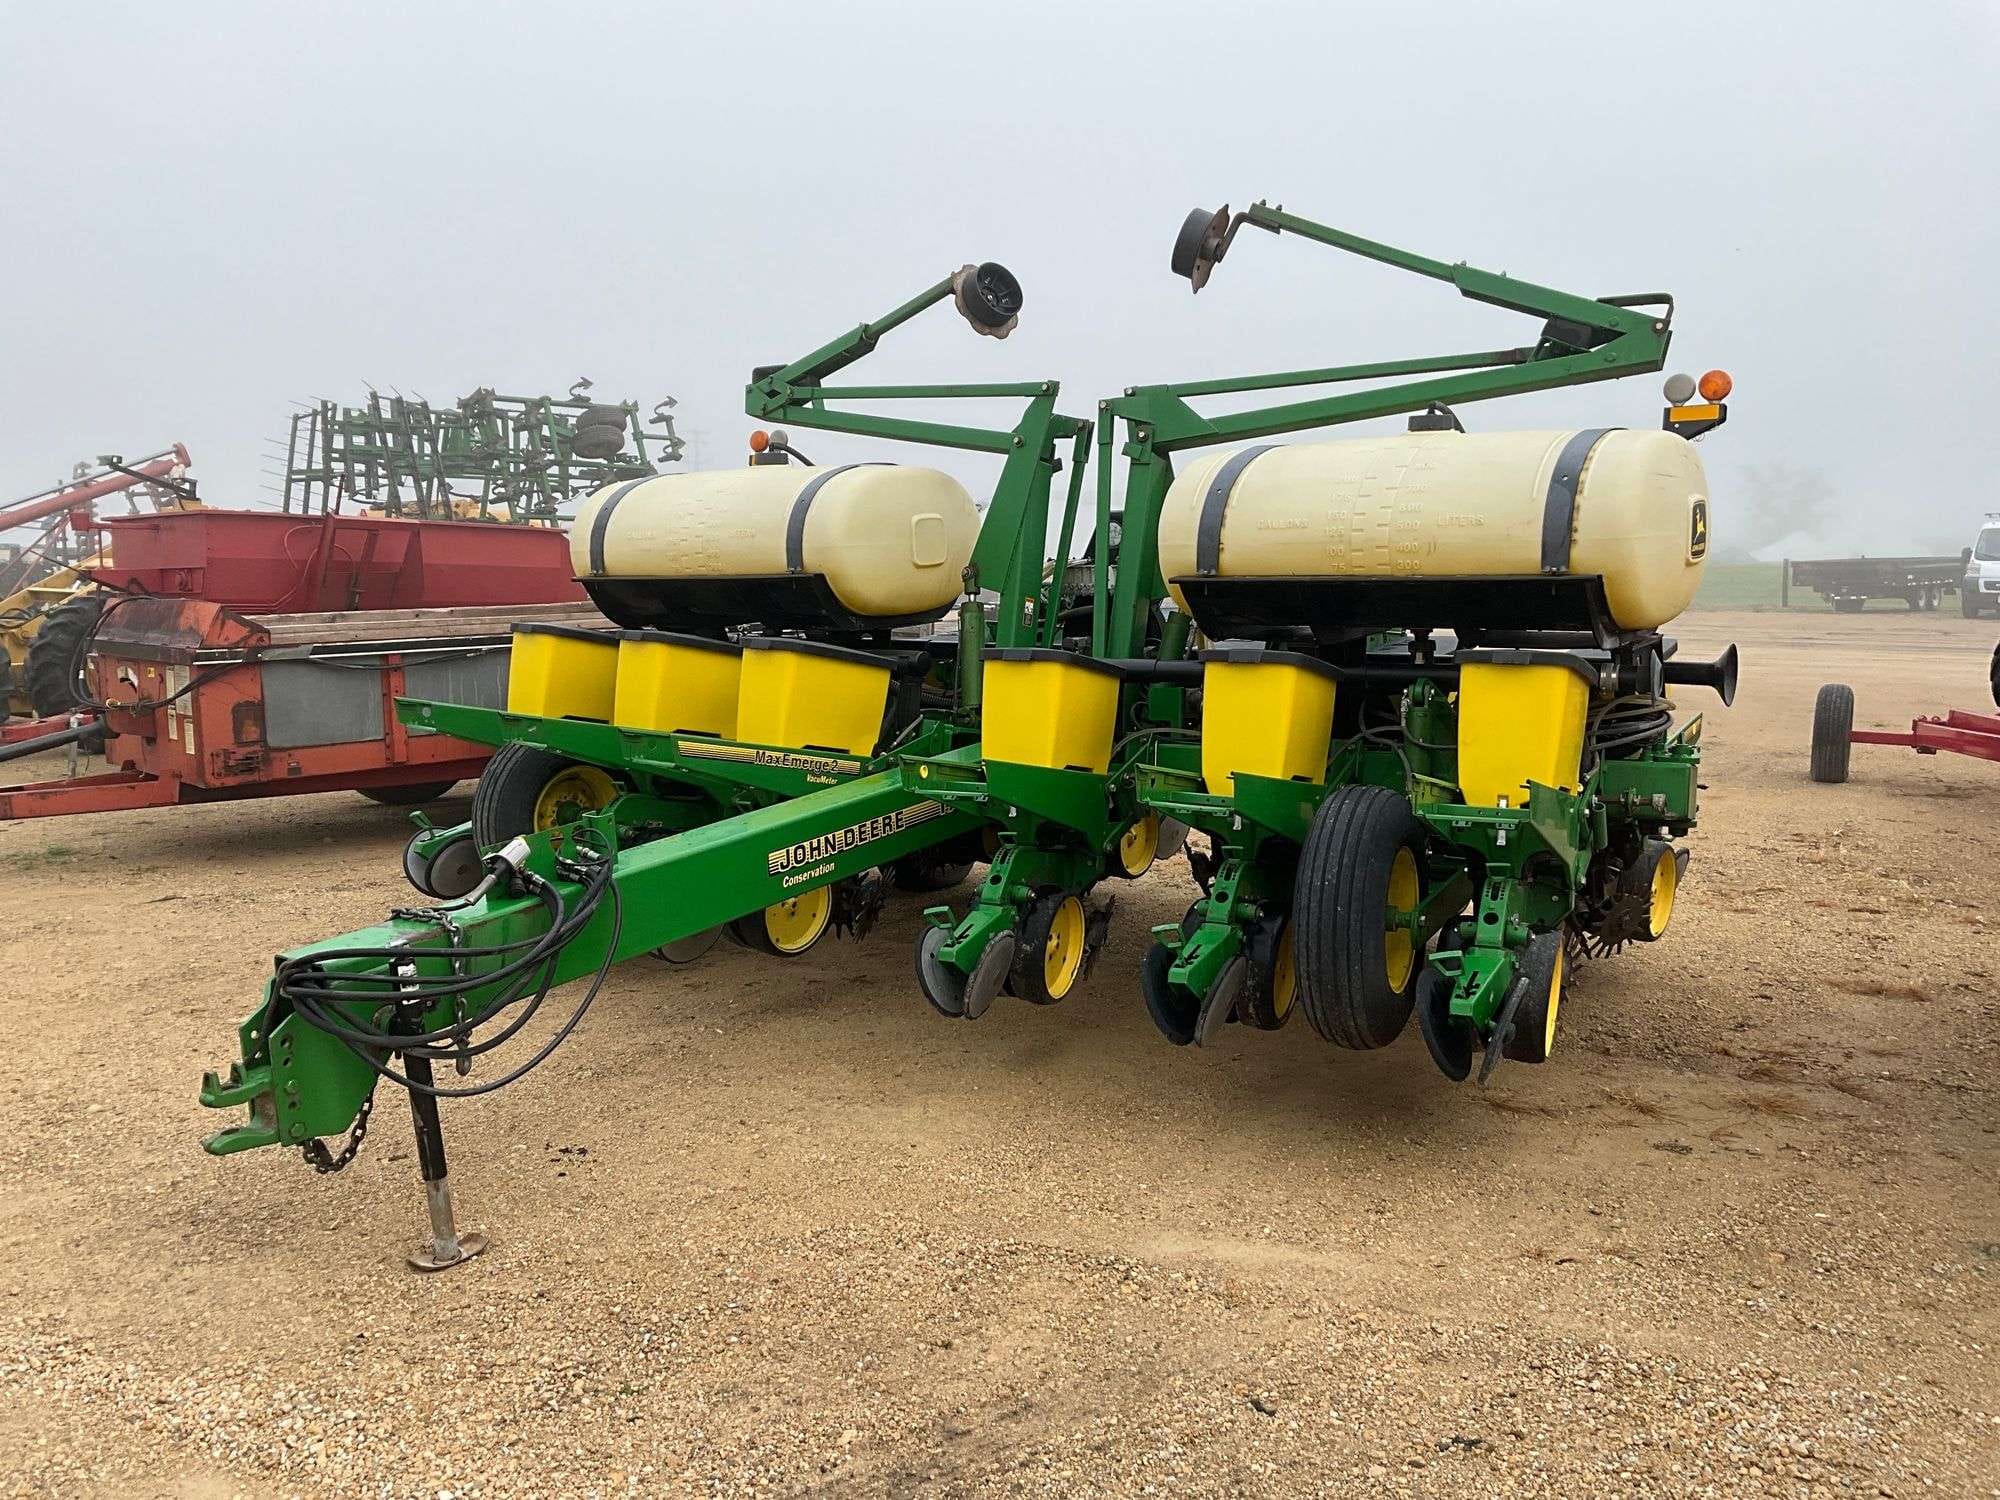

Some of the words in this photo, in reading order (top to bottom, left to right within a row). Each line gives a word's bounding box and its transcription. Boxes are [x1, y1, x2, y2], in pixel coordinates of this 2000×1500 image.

[1437, 512, 1486, 527] LITERS
[754, 750, 830, 774] MaxEmerge
[831, 759, 840, 772] 2
[806, 773, 838, 785] VacuMeter
[778, 832, 838, 872] JOHN
[842, 810, 906, 851] DEERE
[782, 862, 835, 888] Conservation
